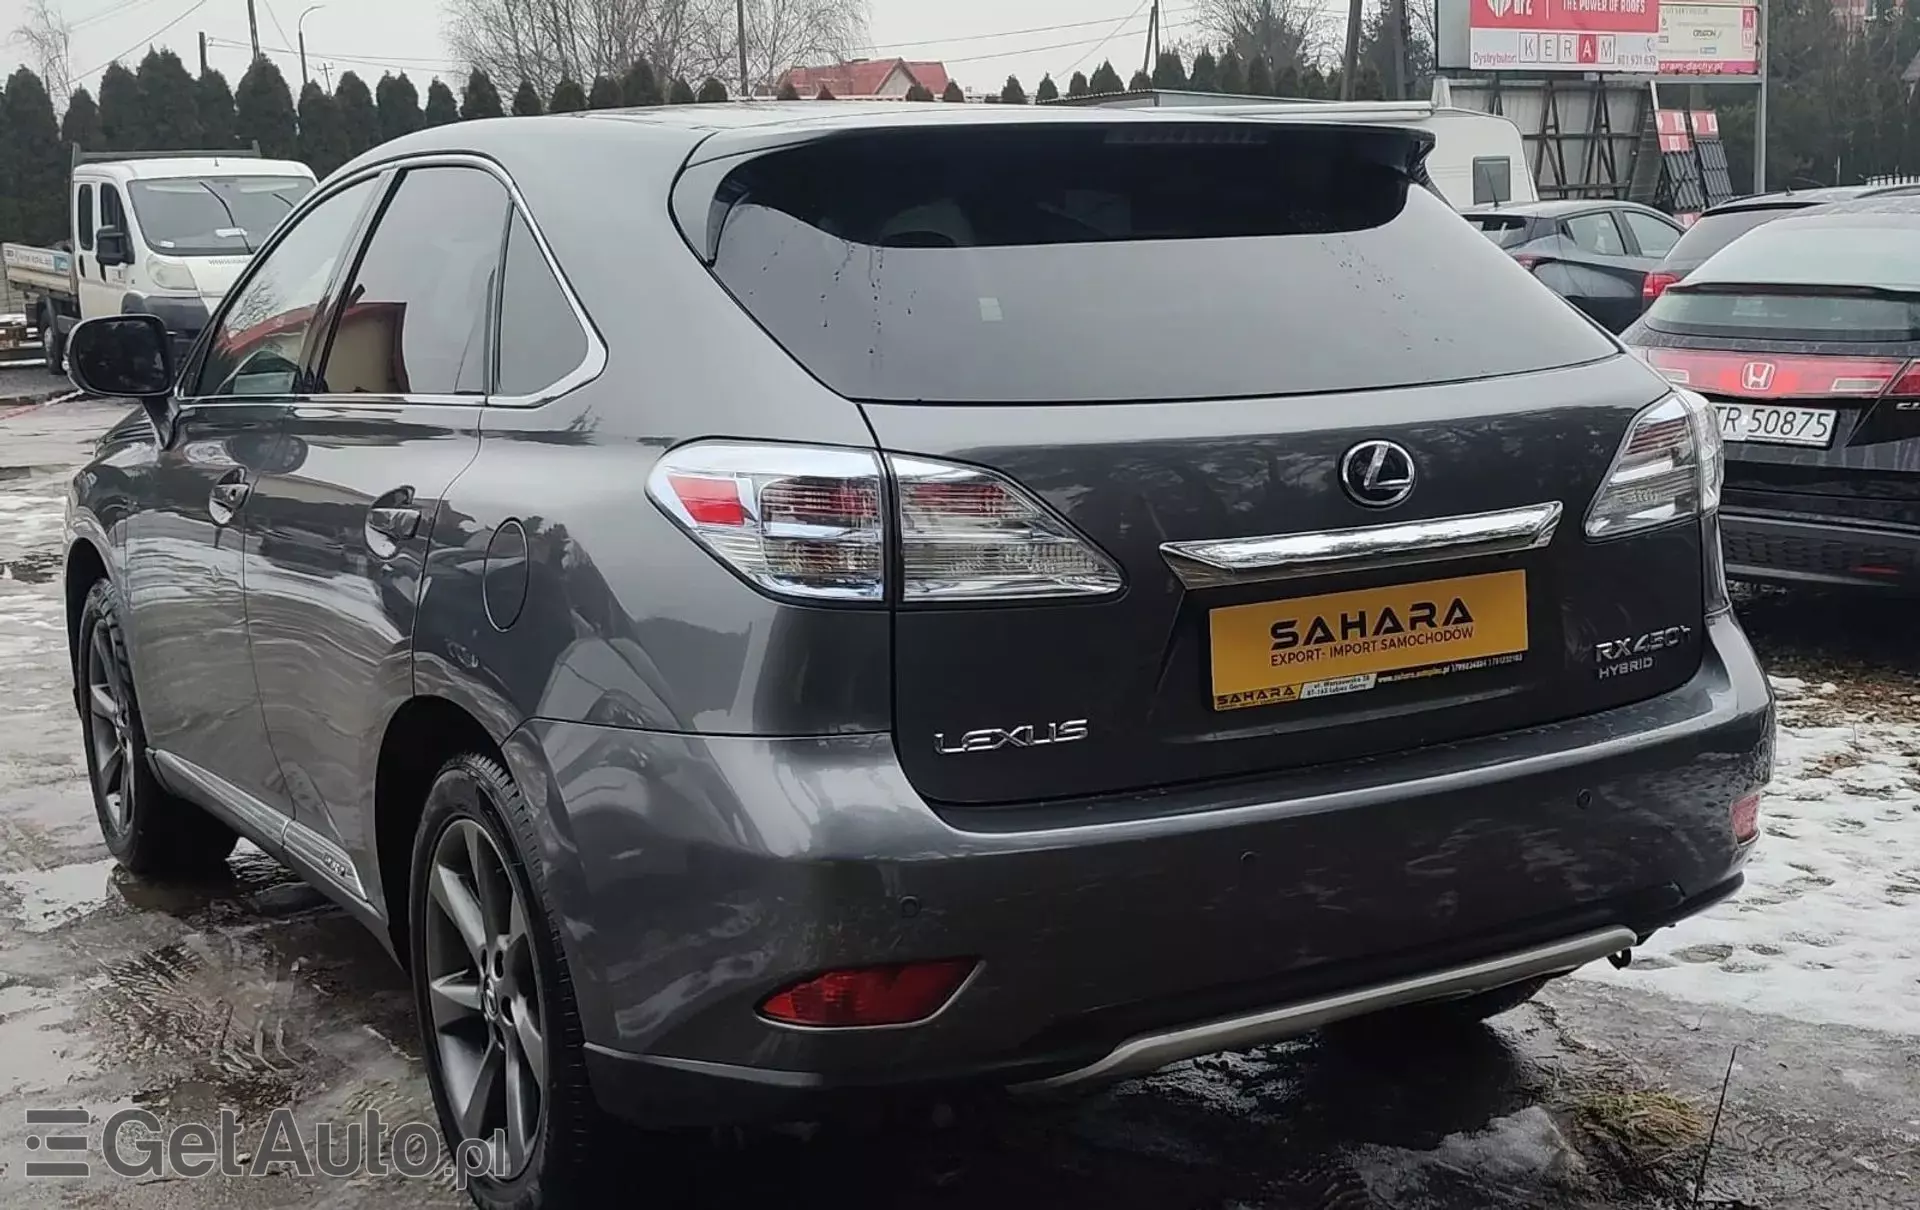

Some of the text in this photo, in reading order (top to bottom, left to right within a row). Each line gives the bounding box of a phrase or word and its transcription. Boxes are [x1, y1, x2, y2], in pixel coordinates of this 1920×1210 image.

[1522, 35, 1614, 60] KERAM
[1747, 407, 1831, 438] 50875
[1270, 597, 1474, 651] SAHARA
[1380, 626, 1475, 651] SAMOCHODÓW
[1598, 656, 1654, 680] HYBRID
[1217, 685, 1295, 706] SAHARA
[934, 718, 1090, 756] LEXUS
